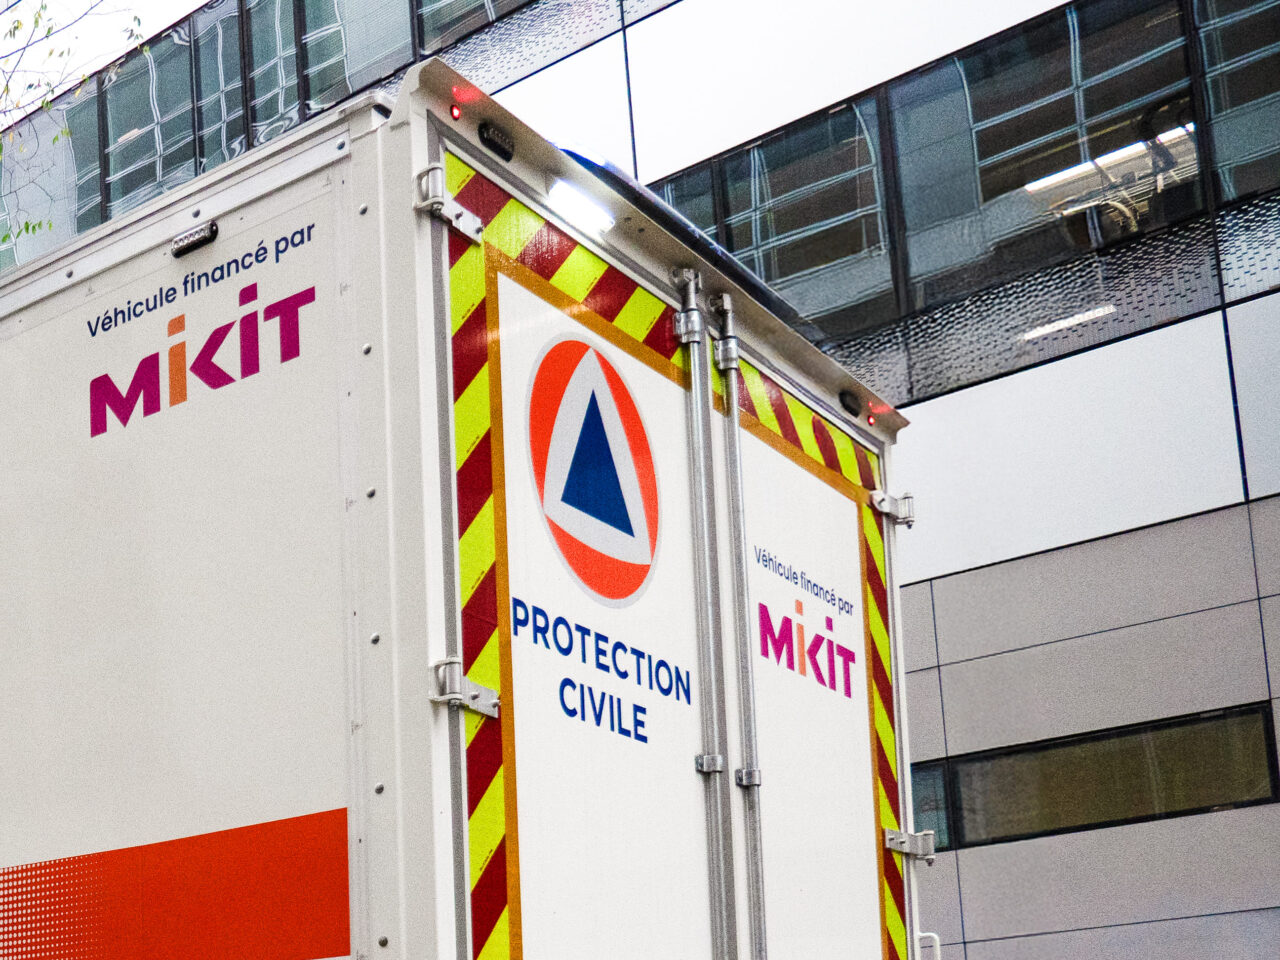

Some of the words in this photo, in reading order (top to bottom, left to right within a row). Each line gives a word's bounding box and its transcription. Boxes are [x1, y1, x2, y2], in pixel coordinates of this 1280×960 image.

[86, 286, 178, 338] Véhicule
[182, 239, 269, 297] financé
[274, 223, 316, 264] par
[754, 544, 799, 590] Véhicule
[799, 570, 837, 607] financé
[837, 598, 854, 617] par
[512, 597, 691, 705] PROTECTION
[558, 677, 648, 744] CIVILE
